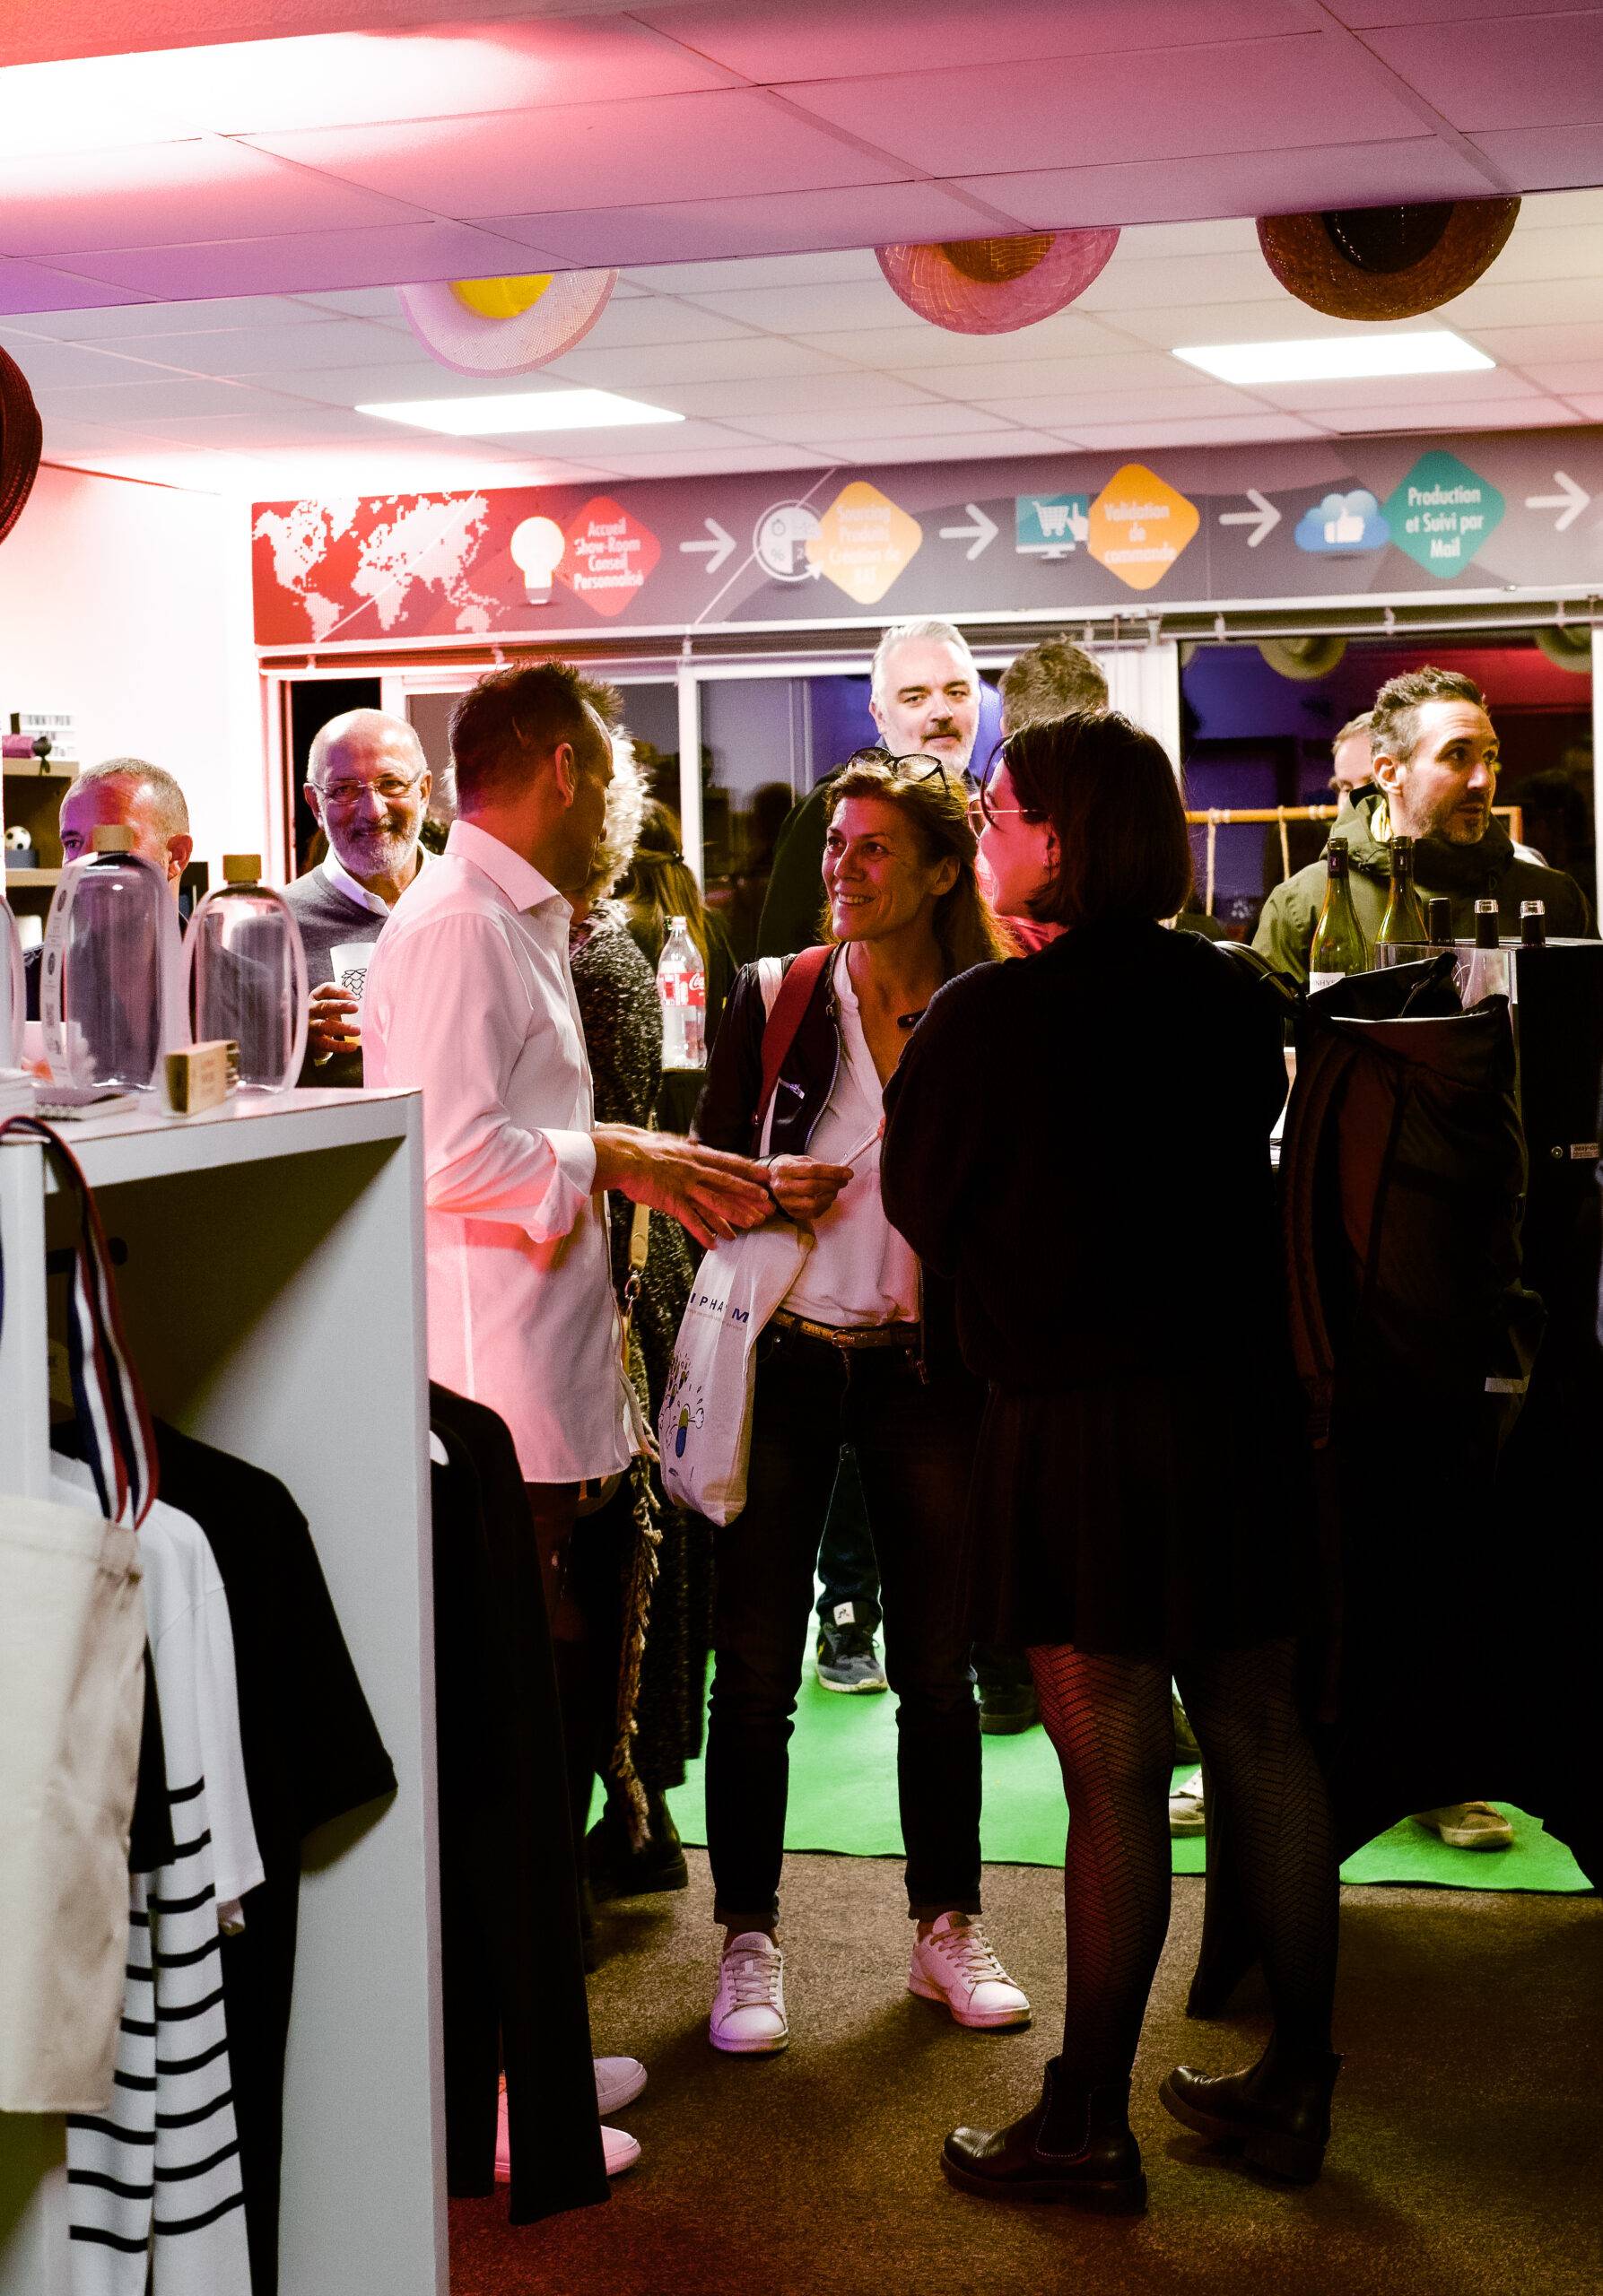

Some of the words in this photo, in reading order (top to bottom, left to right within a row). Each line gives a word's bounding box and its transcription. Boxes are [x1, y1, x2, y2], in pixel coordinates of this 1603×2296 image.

[1407, 483, 1481, 507] Production
[1103, 500, 1170, 521] Validation
[588, 517, 626, 537] Accueil
[1128, 521, 1146, 542] de
[1405, 515, 1419, 534] et
[1422, 512, 1457, 533] Suivi
[1459, 515, 1484, 535] par
[1430, 536, 1460, 557] Mail
[588, 552, 628, 572] Conseil
